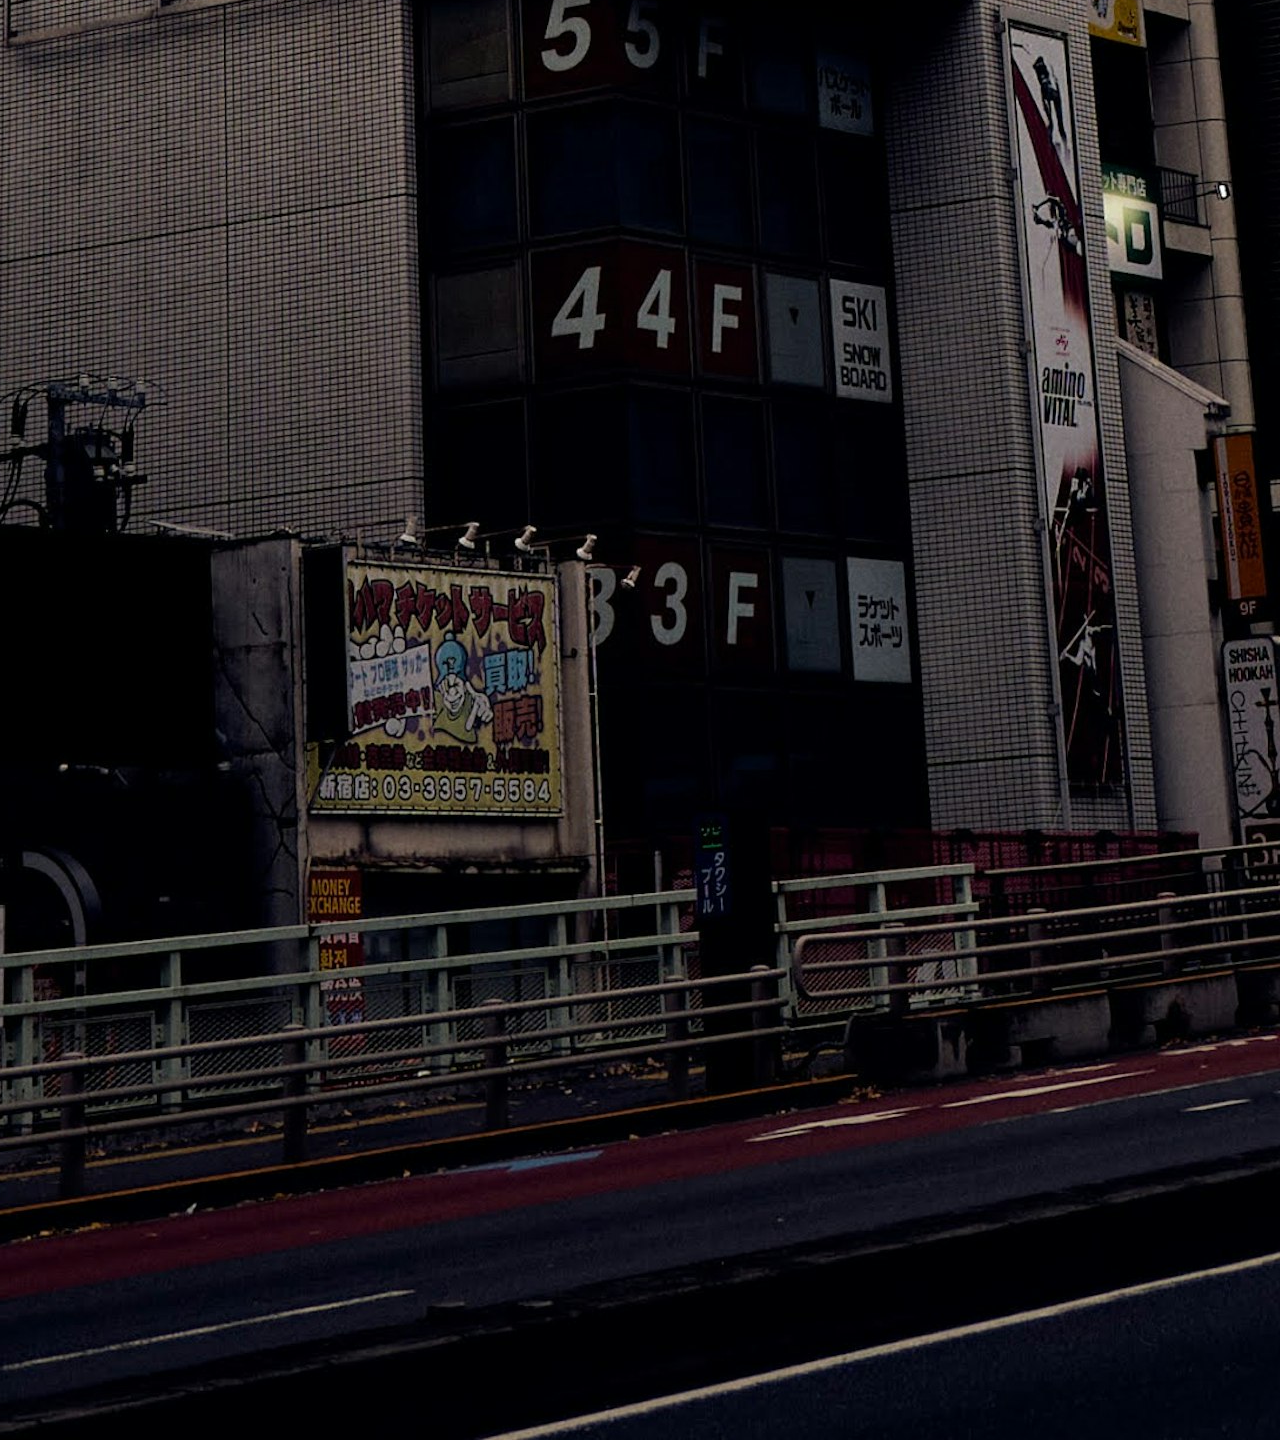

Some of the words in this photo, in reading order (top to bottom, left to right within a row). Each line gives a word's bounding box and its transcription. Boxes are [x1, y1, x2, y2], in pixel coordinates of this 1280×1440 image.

[550, 265, 606, 350] 4
[635, 267, 743, 354] 4F
[841, 295, 878, 332] SKI
[842, 342, 882, 369] SNOW
[840, 365, 887, 393] BOARD
[1041, 361, 1086, 399] amino
[1043, 395, 1078, 428] VITAL
[650, 560, 759, 647] 3F
[1239, 600, 1257, 617] 9F
[857, 621, 904, 650] スポーツ
[1228, 647, 1271, 665] SHISHA
[1228, 663, 1274, 684] HOOKAH
[493, 695, 543, 744] 販売!
[311, 877, 352, 897] MONEY
[700, 865, 715, 915] プール
[713, 850, 728, 913] タクシー
